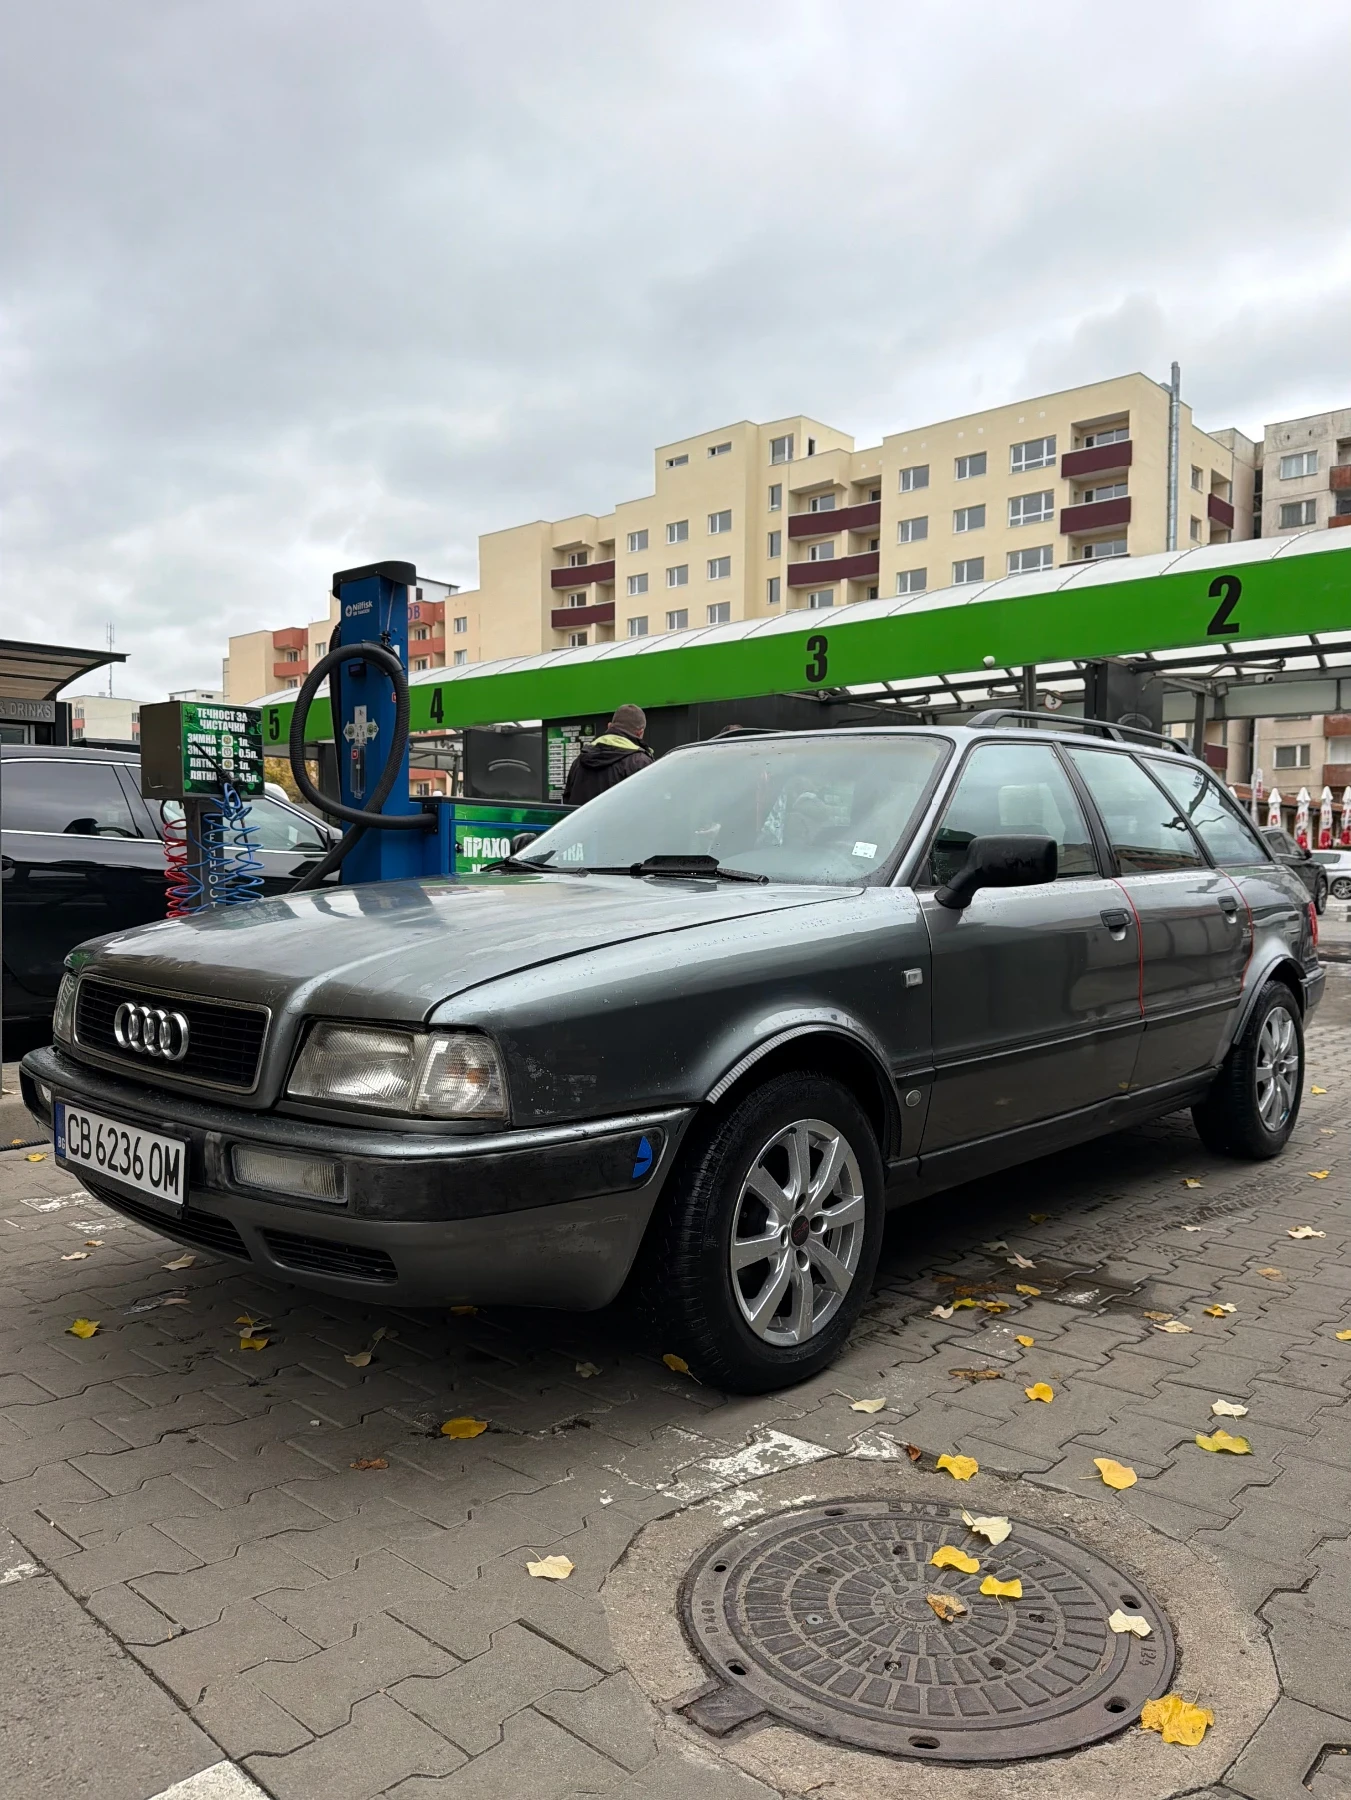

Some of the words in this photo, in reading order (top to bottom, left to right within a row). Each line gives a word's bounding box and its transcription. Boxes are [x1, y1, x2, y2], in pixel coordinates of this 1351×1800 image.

[352, 600, 373, 611] Nilfisk
[1207, 575, 1242, 636] 2
[806, 635, 828, 682] 3
[10, 702, 52, 718] DRINKS
[430, 688, 444, 723] 4
[197, 708, 235, 722] ТЕЧНОСТ
[236, 712, 248, 722] ЗА
[200, 719, 246, 733] ЧИСТАЧКИ
[269, 708, 280, 740] 5
[187, 733, 217, 745] ЗИМНА
[238, 748, 258, 759] 0.5л.
[189, 770, 218, 781] ЛЯТНА
[57, 1136, 66, 1150] BG
[96, 1123, 144, 1181] 6236
[149, 1141, 180, 1196] OM
